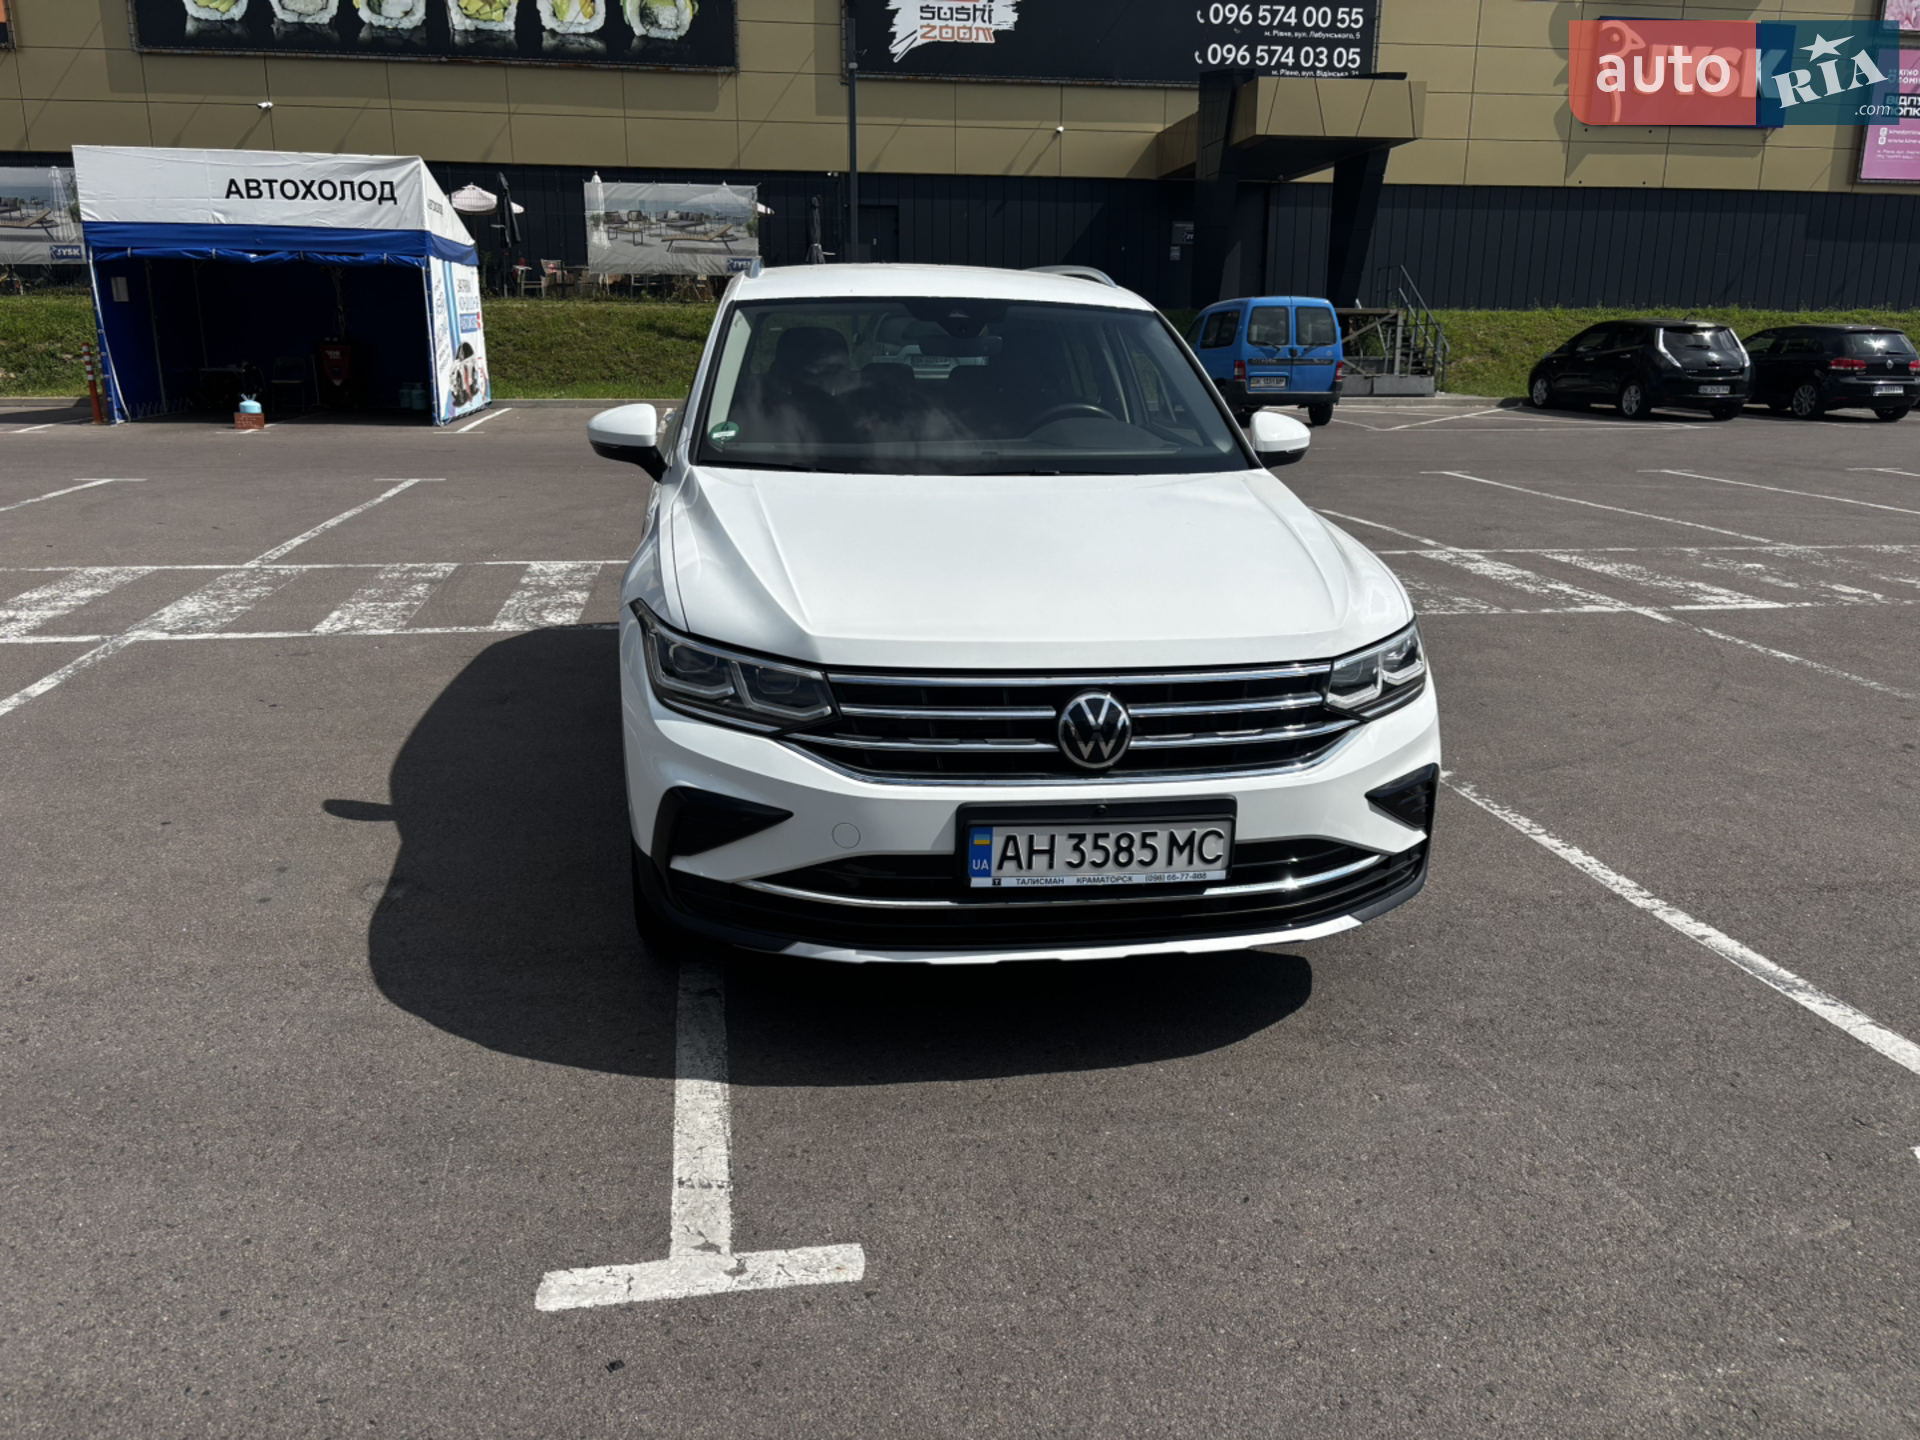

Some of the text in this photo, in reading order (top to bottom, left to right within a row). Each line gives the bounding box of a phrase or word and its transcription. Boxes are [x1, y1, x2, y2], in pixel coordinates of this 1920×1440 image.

[1209, 3, 1364, 29] 096 574 00 55
[1207, 44, 1361, 69] 096 574 03 05
[225, 178, 398, 205] АВТОХОЛОД
[57, 247, 81, 256] JYSK
[997, 829, 1226, 871] AH 3585 MC
[972, 860, 989, 870] UA
[1016, 877, 1064, 885] ТАЛИСМАН
[1076, 876, 1133, 884] КРАМАТОРСК
